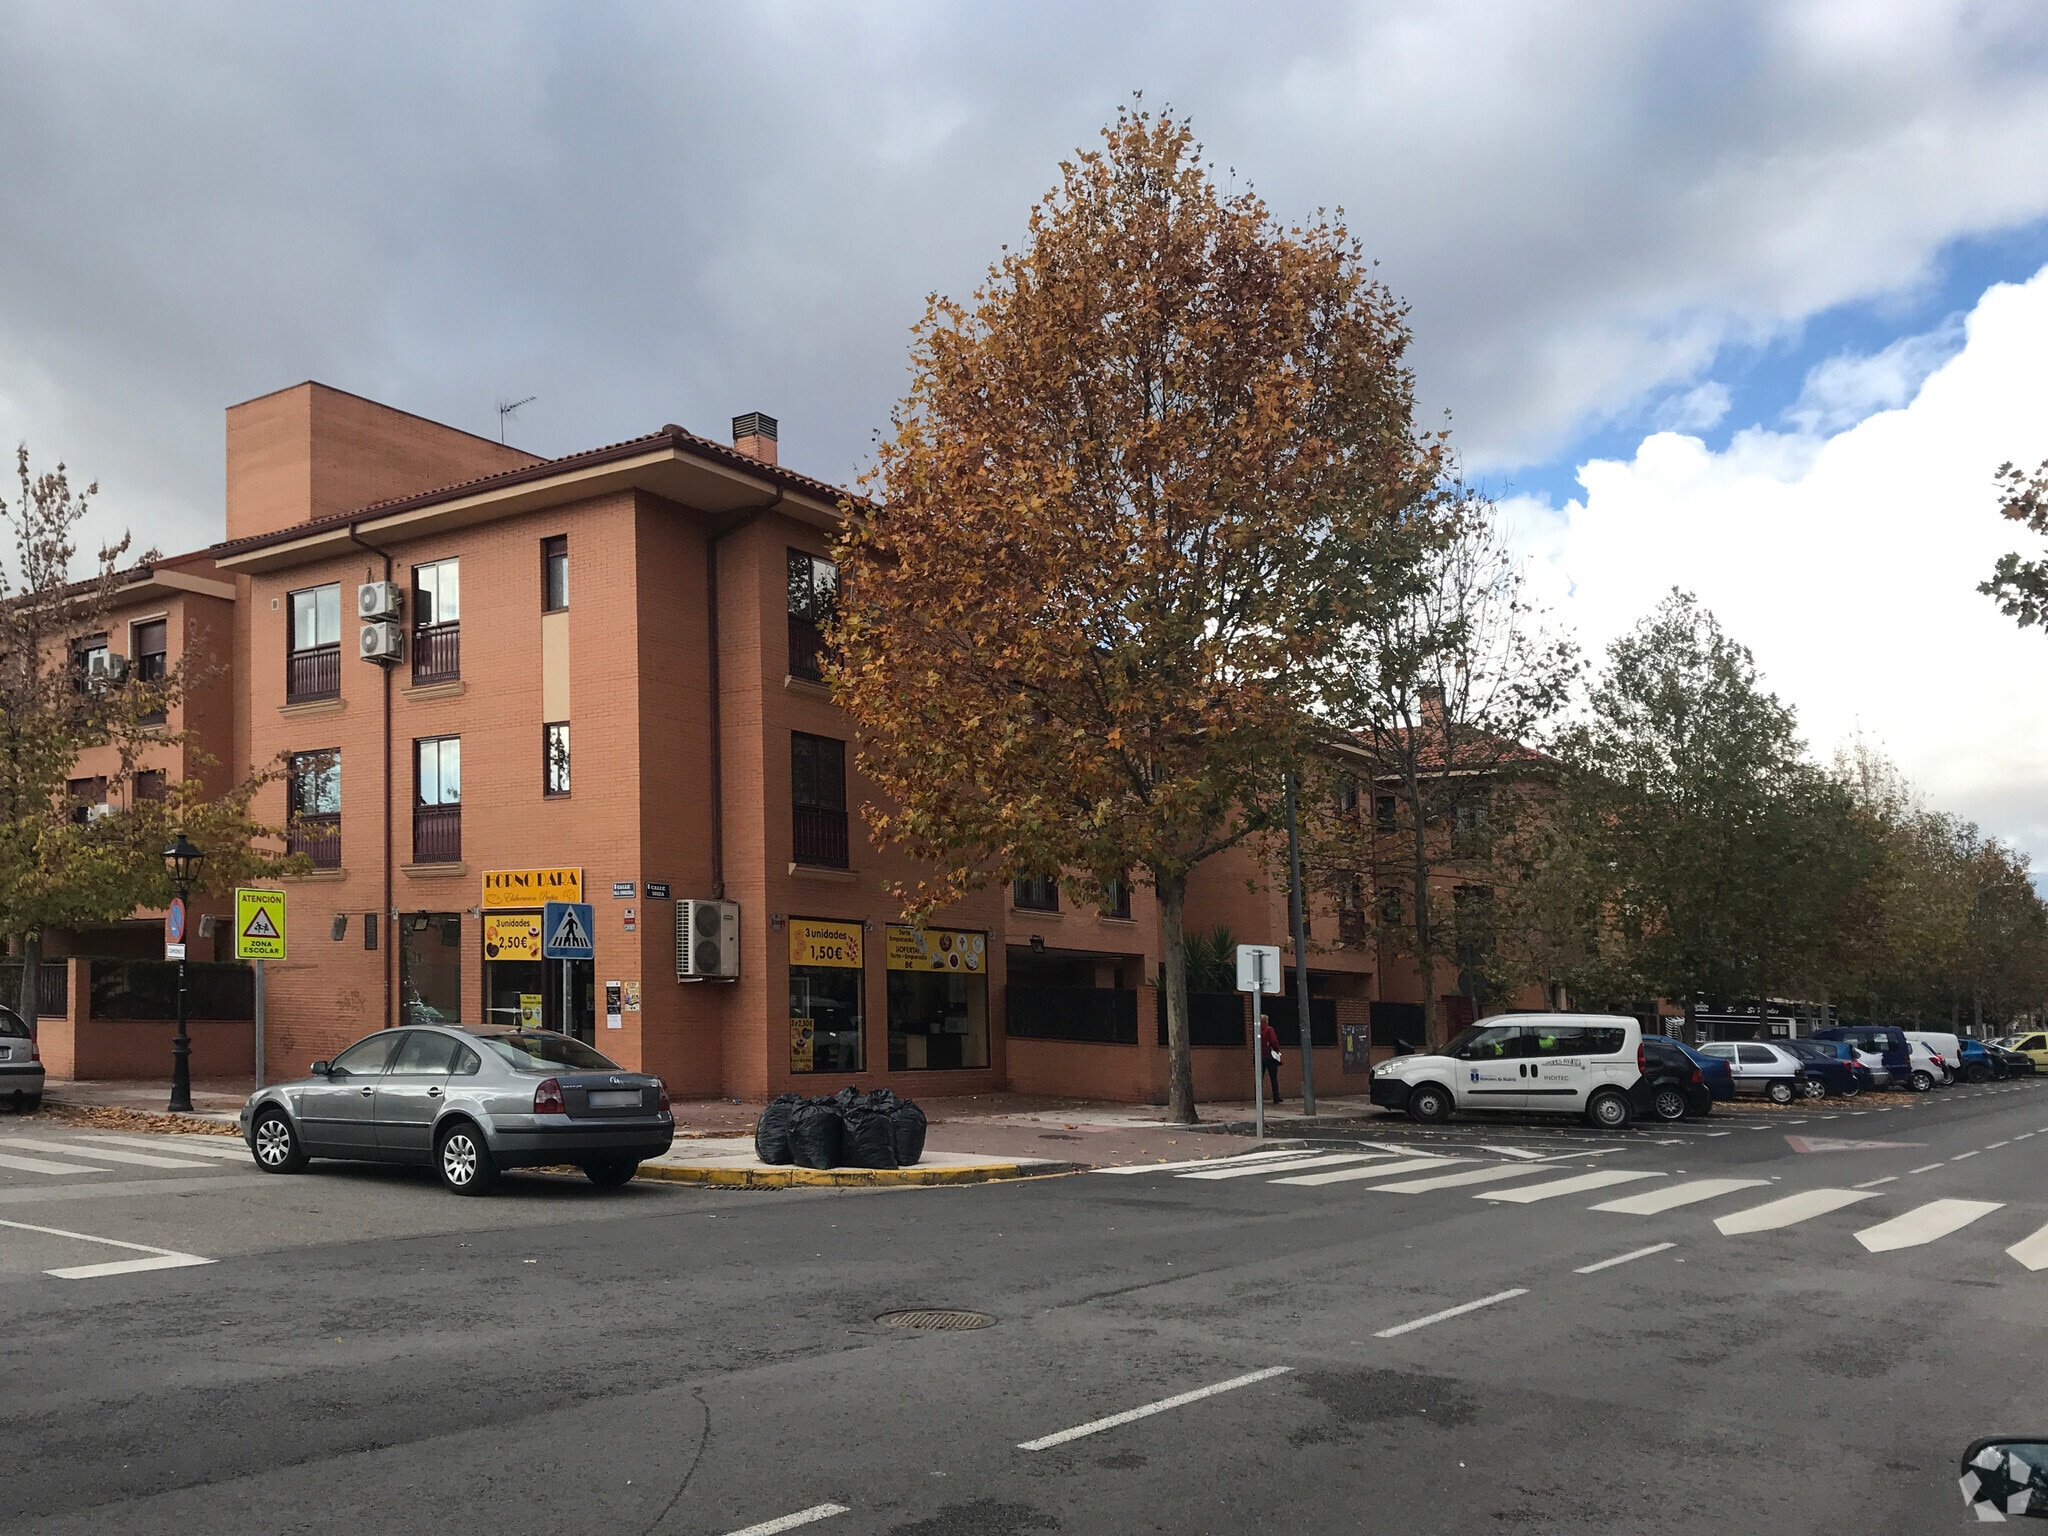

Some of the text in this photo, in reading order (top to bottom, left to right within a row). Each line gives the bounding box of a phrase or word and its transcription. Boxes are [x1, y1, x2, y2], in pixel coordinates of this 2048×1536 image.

[486, 872, 578, 888] HORNO DARA
[496, 918, 530, 928] 3 unidades
[805, 927, 847, 940] 3 unidades
[499, 936, 528, 950] 2,50€
[810, 945, 843, 960] 1,50€
